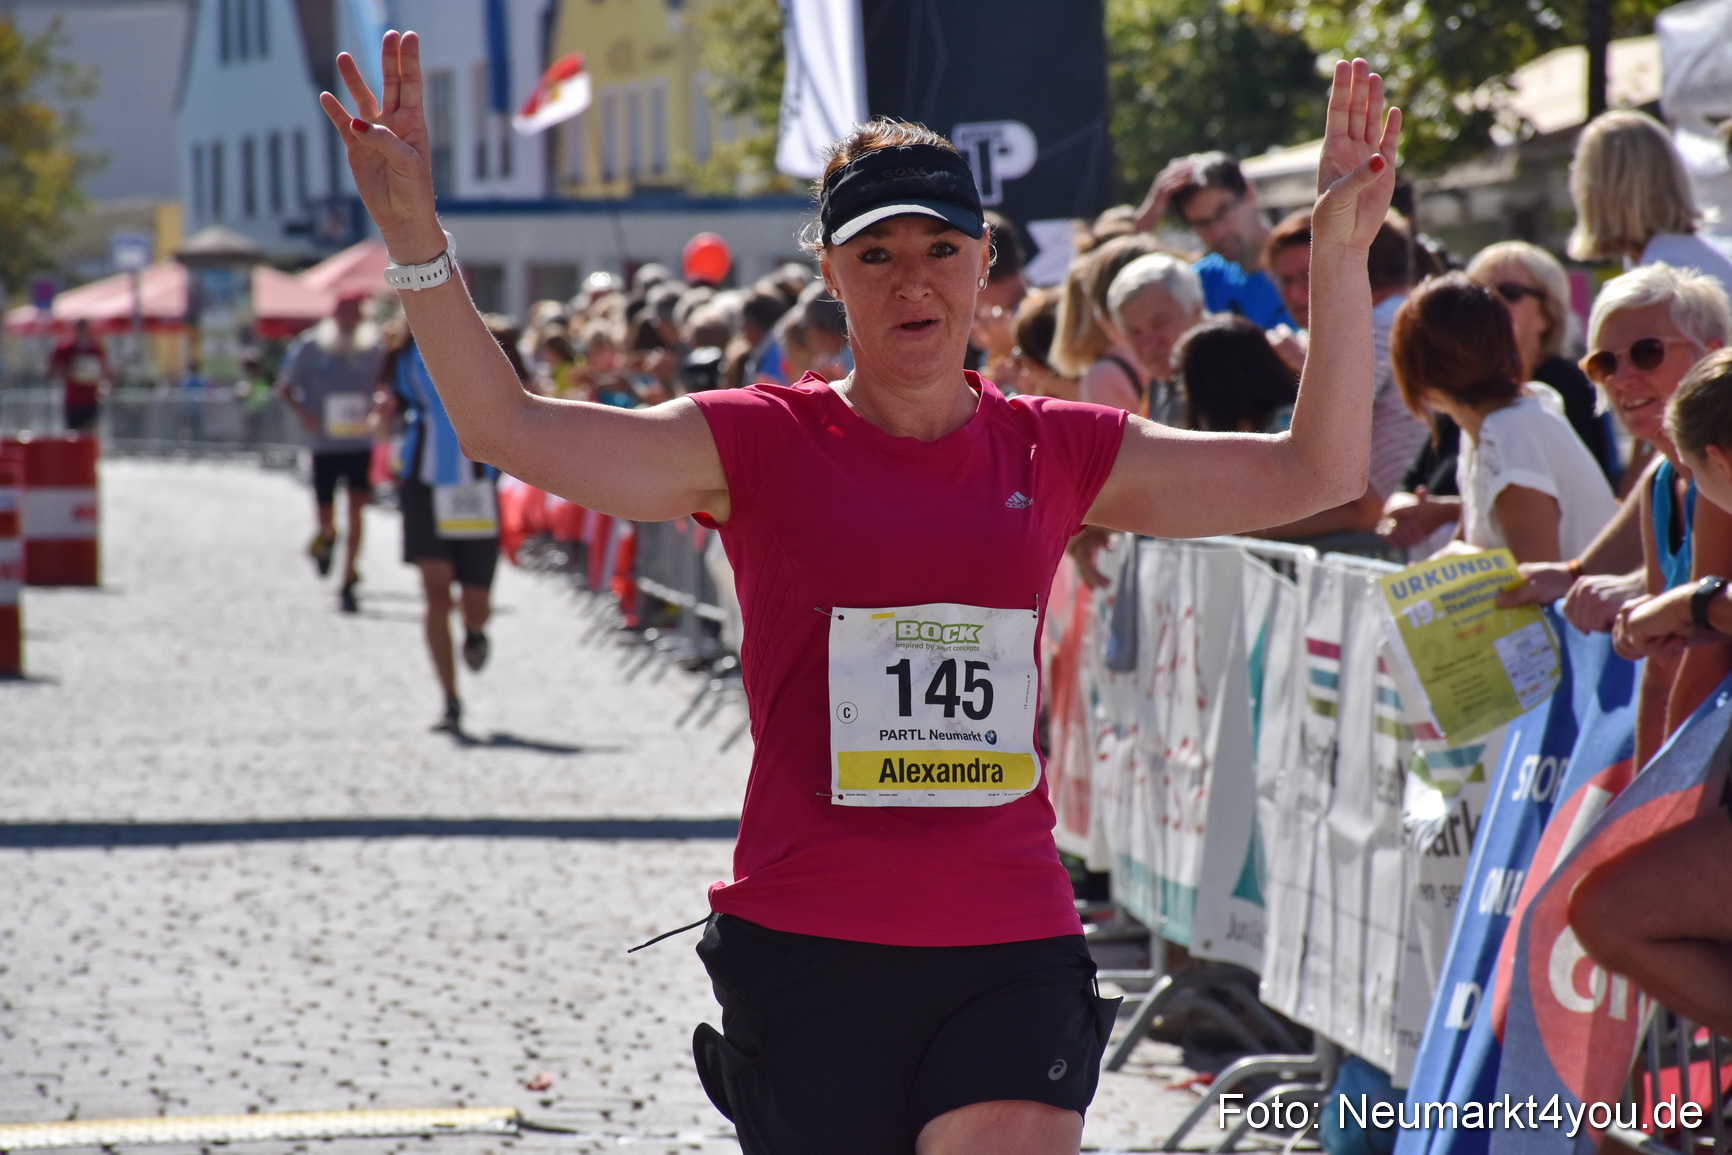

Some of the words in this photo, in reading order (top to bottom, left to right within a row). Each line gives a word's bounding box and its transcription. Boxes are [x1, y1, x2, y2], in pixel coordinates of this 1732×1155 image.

[883, 167, 927, 178] GORE
[1390, 555, 1508, 600] URKUNDE
[1402, 600, 1444, 628] 19.
[896, 620, 984, 644] BOCK
[926, 643, 935, 651] by
[886, 658, 994, 720] 145
[843, 707, 851, 719] C
[880, 729, 926, 741] PARTL
[929, 729, 983, 742] Neumarkt
[879, 758, 1003, 783] Alexandra
